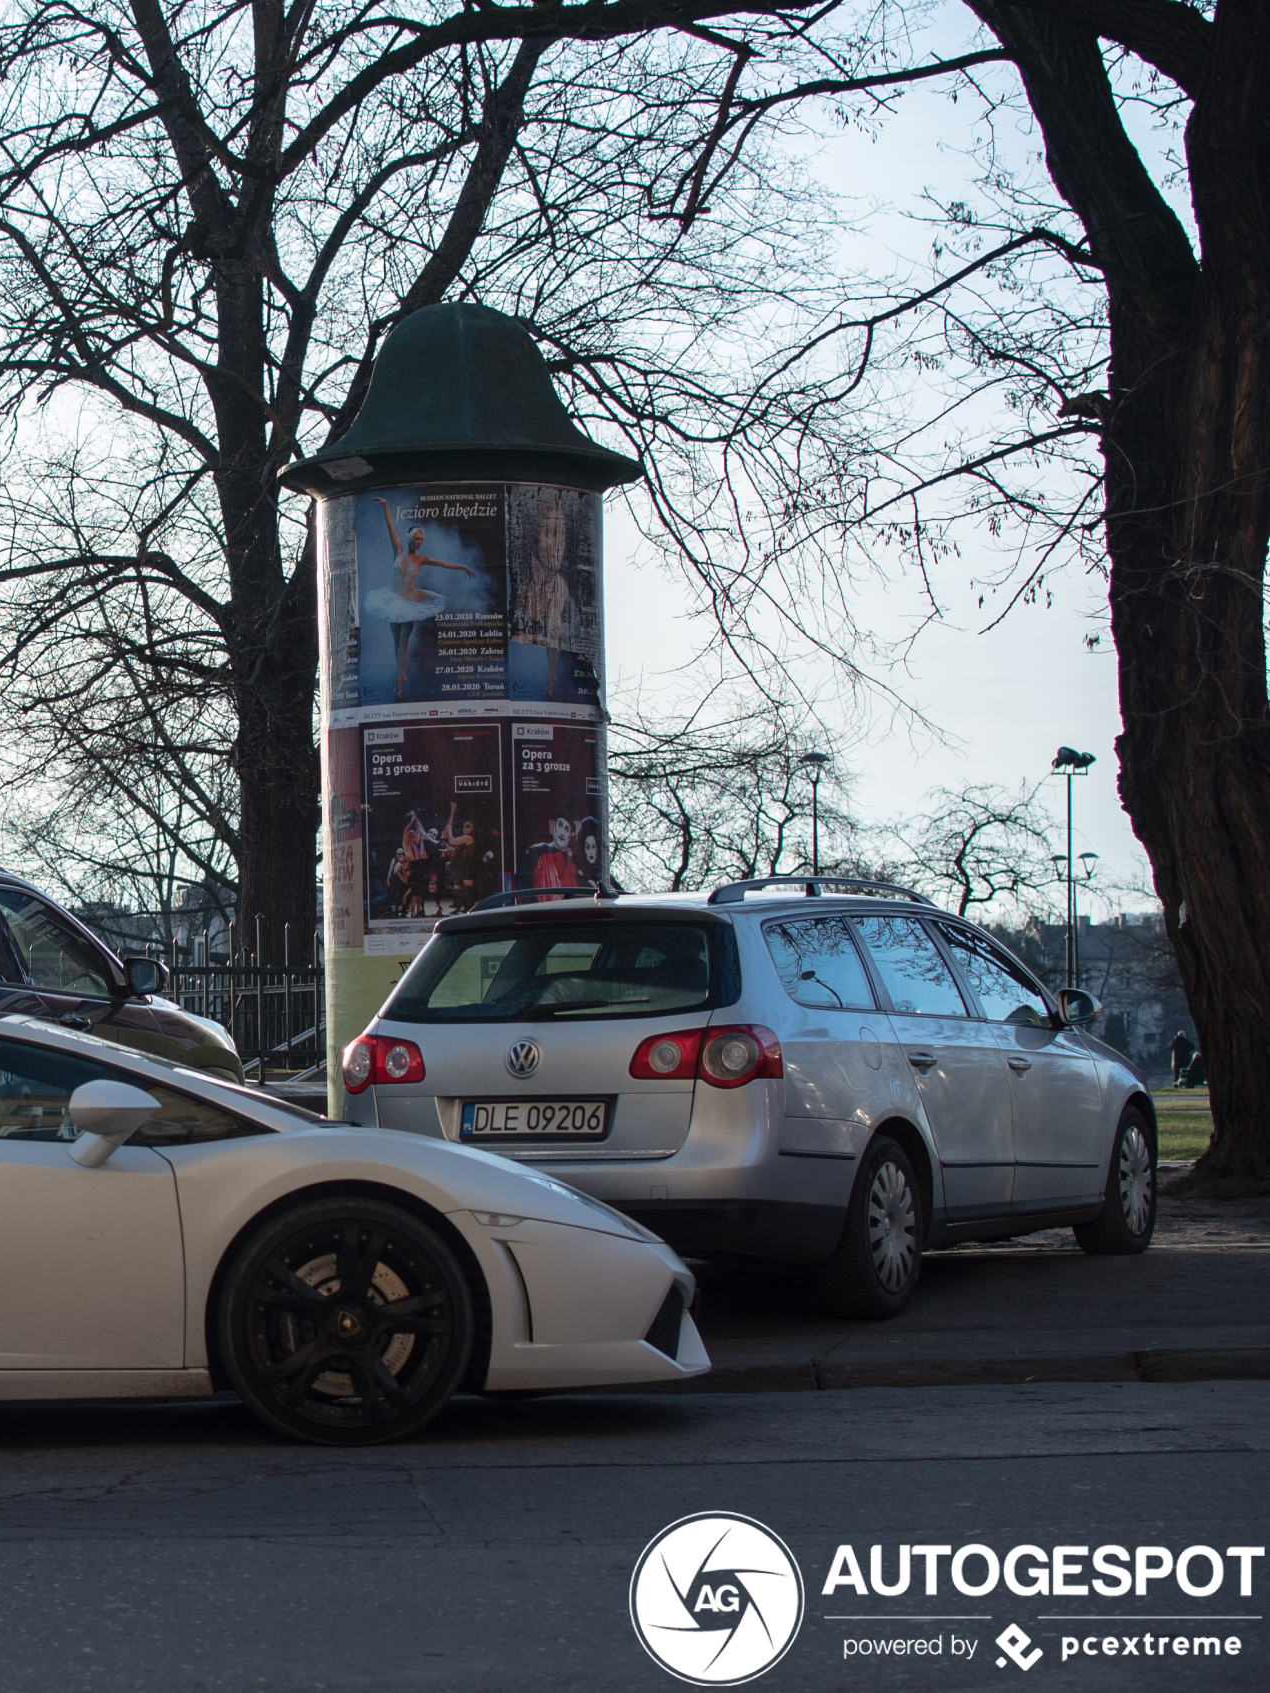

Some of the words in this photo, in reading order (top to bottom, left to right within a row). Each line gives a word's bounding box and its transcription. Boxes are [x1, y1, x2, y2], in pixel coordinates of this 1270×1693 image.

[395, 505, 439, 523] Jezioro
[443, 502, 497, 520] łabędzie
[435, 613, 474, 621] 23.01.2020
[475, 612, 504, 620] Rzeszów
[437, 630, 477, 639] 24.01.2020
[438, 648, 477, 656] 26.01.2020
[435, 666, 474, 674] 27.01.2020
[477, 665, 504, 673] Kraków
[441, 683, 480, 691] 28.01.2020
[526, 727, 550, 736] Kraków
[376, 732, 400, 741] Kraków
[372, 753, 403, 766] Opera
[522, 749, 553, 761] Opera
[372, 766, 383, 775] za
[385, 766, 391, 776] 3
[393, 763, 429, 776] grosze
[522, 762, 534, 770] za
[536, 763, 542, 772] 3
[544, 763, 571, 773] grosze
[458, 779, 489, 787] VARIÉTÉ
[474, 1105, 520, 1132] DLE
[527, 1105, 601, 1131] 09206
[463, 1123, 472, 1131] PL
